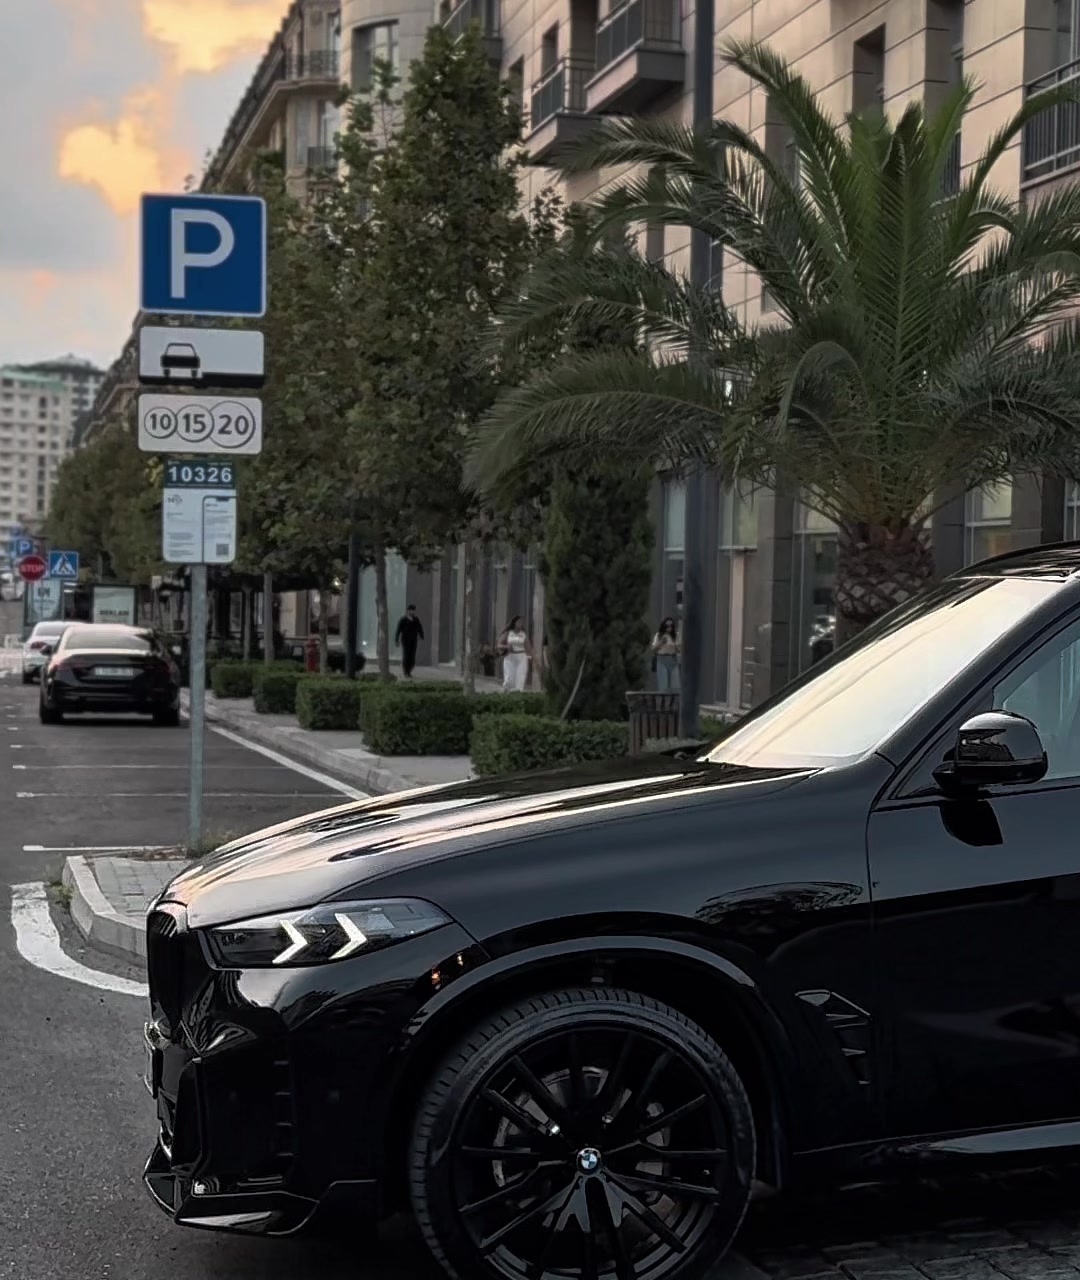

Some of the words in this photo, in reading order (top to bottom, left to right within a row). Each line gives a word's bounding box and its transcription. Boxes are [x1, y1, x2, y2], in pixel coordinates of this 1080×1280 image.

[170, 207, 235, 299] P
[150, 413, 172, 431] 10
[182, 413, 206, 433] 15
[218, 414, 249, 435] 20
[169, 466, 232, 483] 10326
[20, 541, 31, 553] P
[20, 564, 45, 573] STOP
